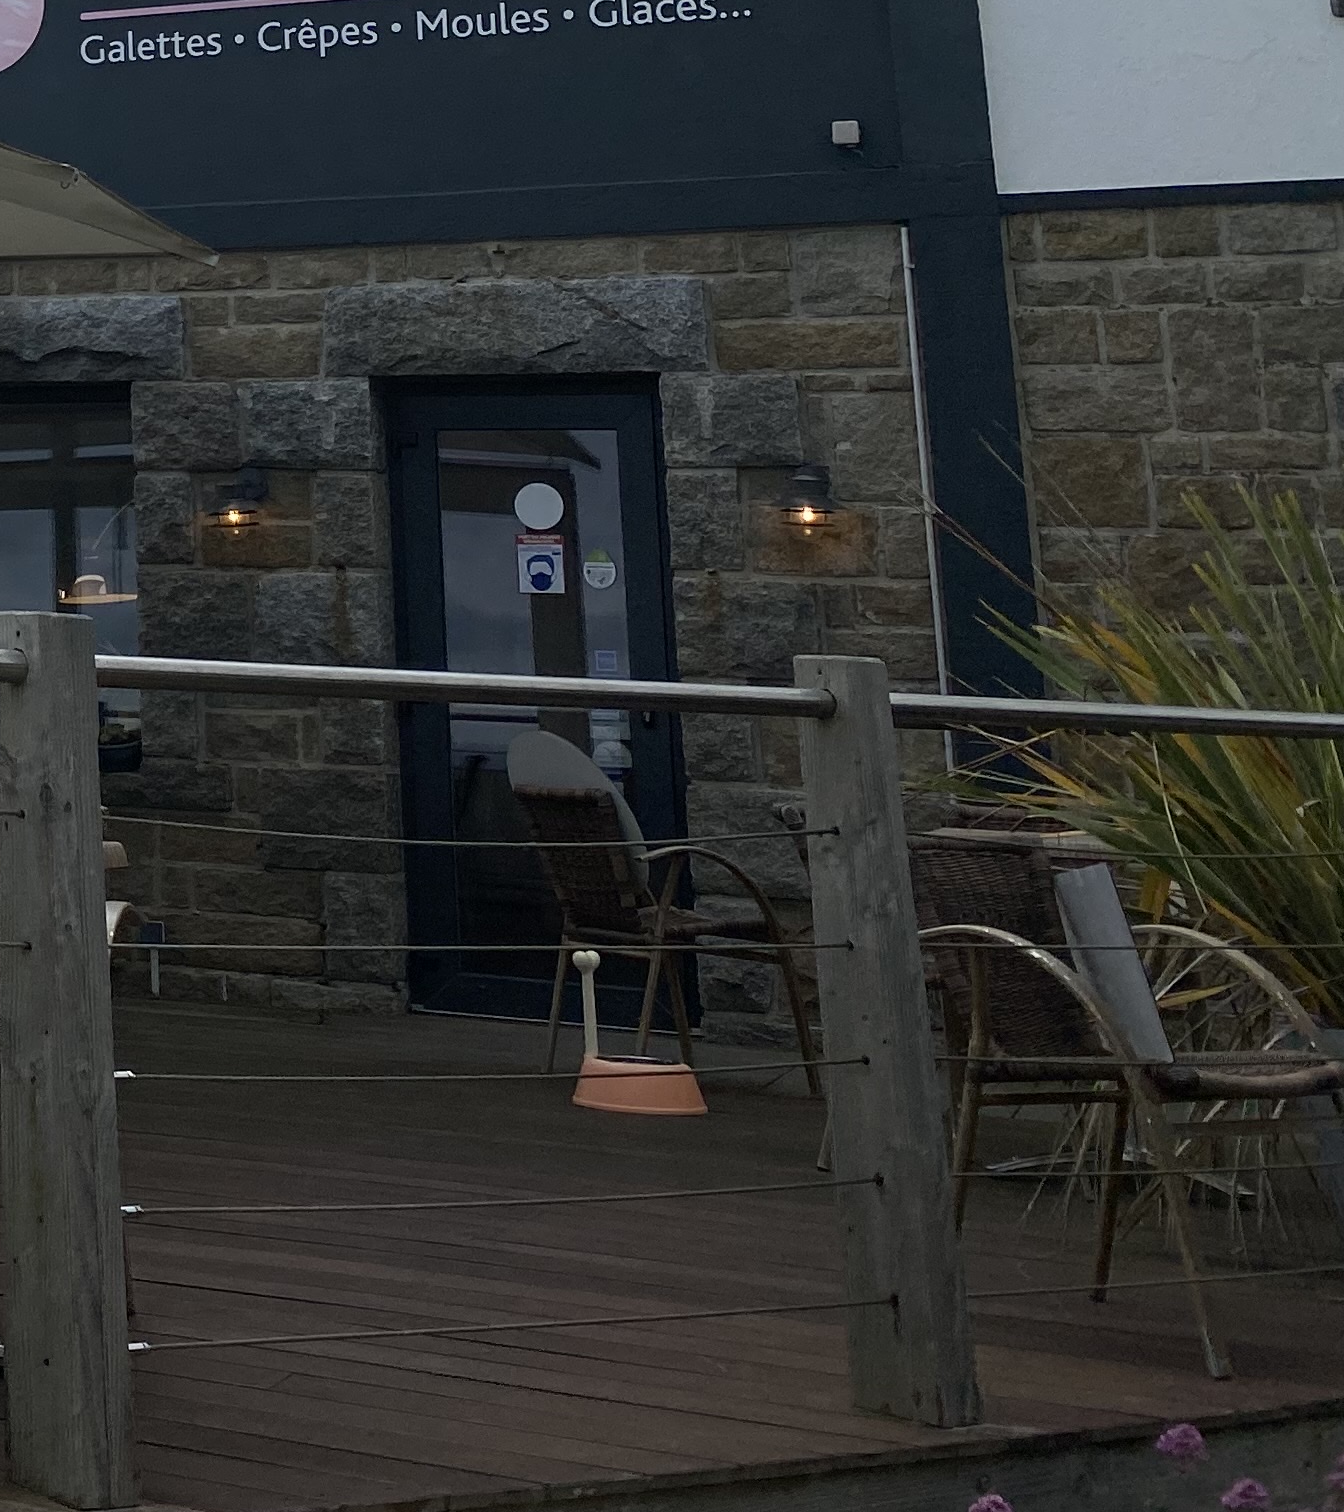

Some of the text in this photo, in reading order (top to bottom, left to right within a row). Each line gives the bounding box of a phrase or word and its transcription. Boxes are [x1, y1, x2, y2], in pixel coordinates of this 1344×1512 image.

[80, 30, 222, 64] Galettes
[257, 18, 378, 58] Crêpes
[416, 2, 550, 41] Moules
